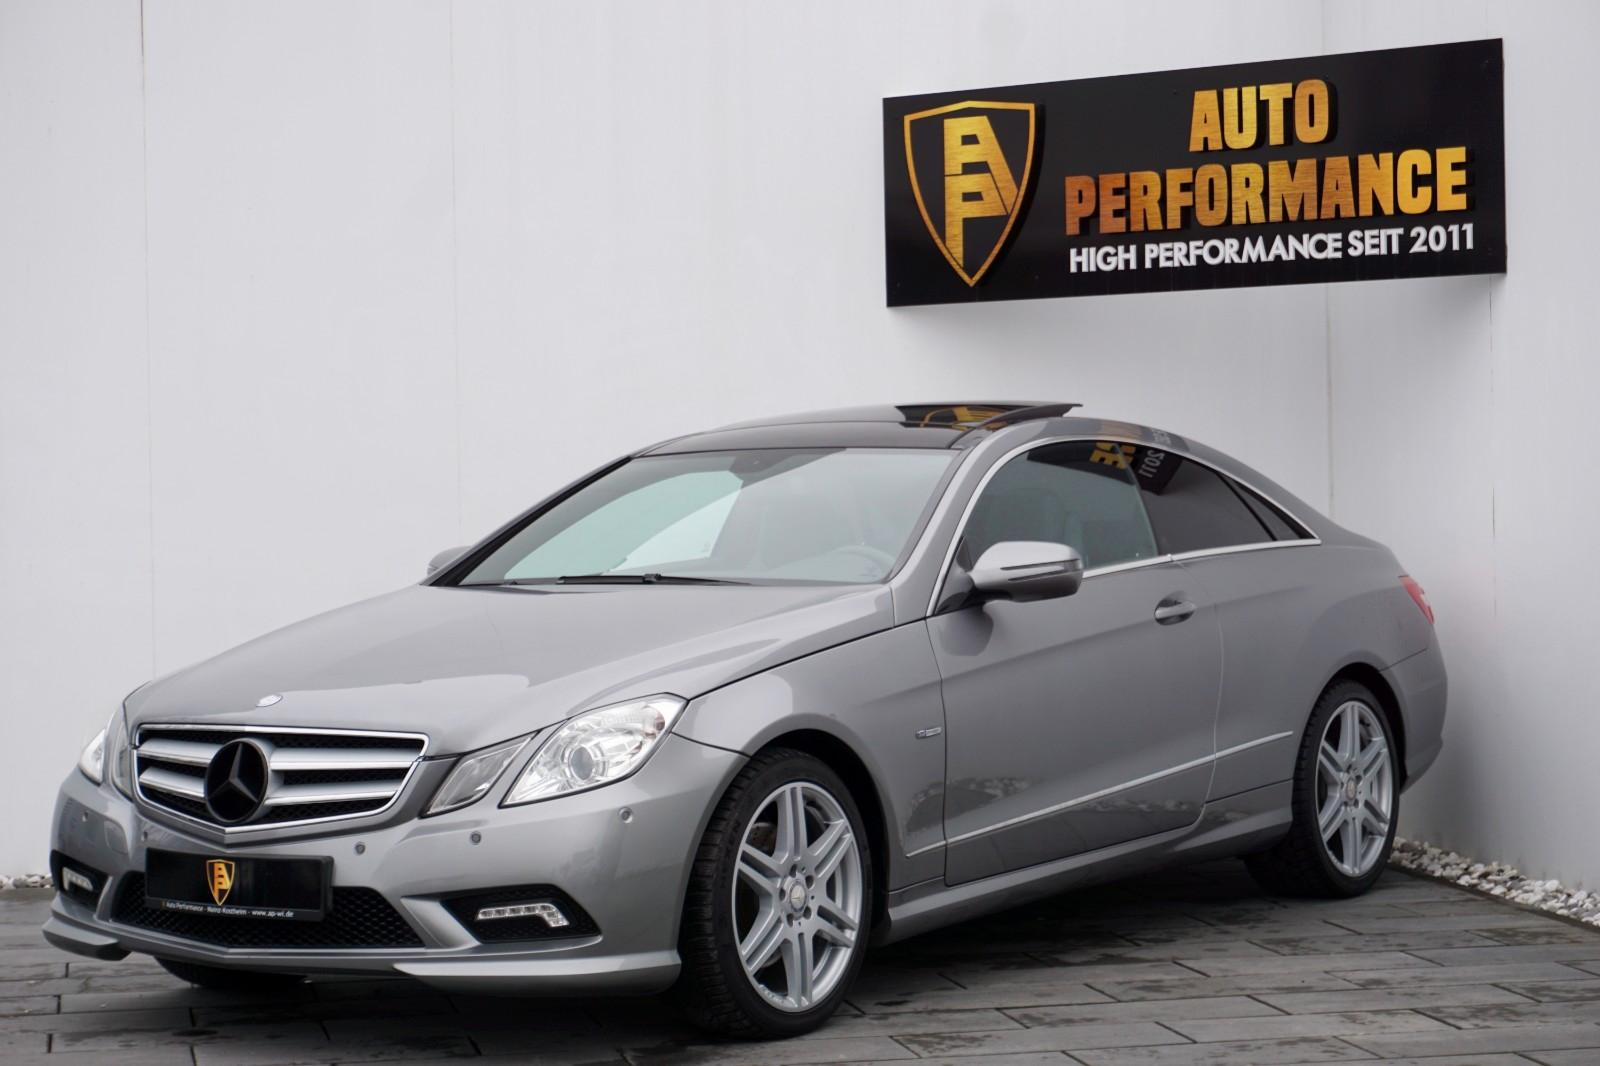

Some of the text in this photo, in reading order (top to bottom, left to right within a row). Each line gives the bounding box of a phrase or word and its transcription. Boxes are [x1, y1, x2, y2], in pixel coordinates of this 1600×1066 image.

[1189, 79, 1330, 152] AUTO
[1065, 147, 1467, 236] PERFORMANCE
[1069, 222, 1475, 273] HIGH PERFORMANCE SEIT 2011
